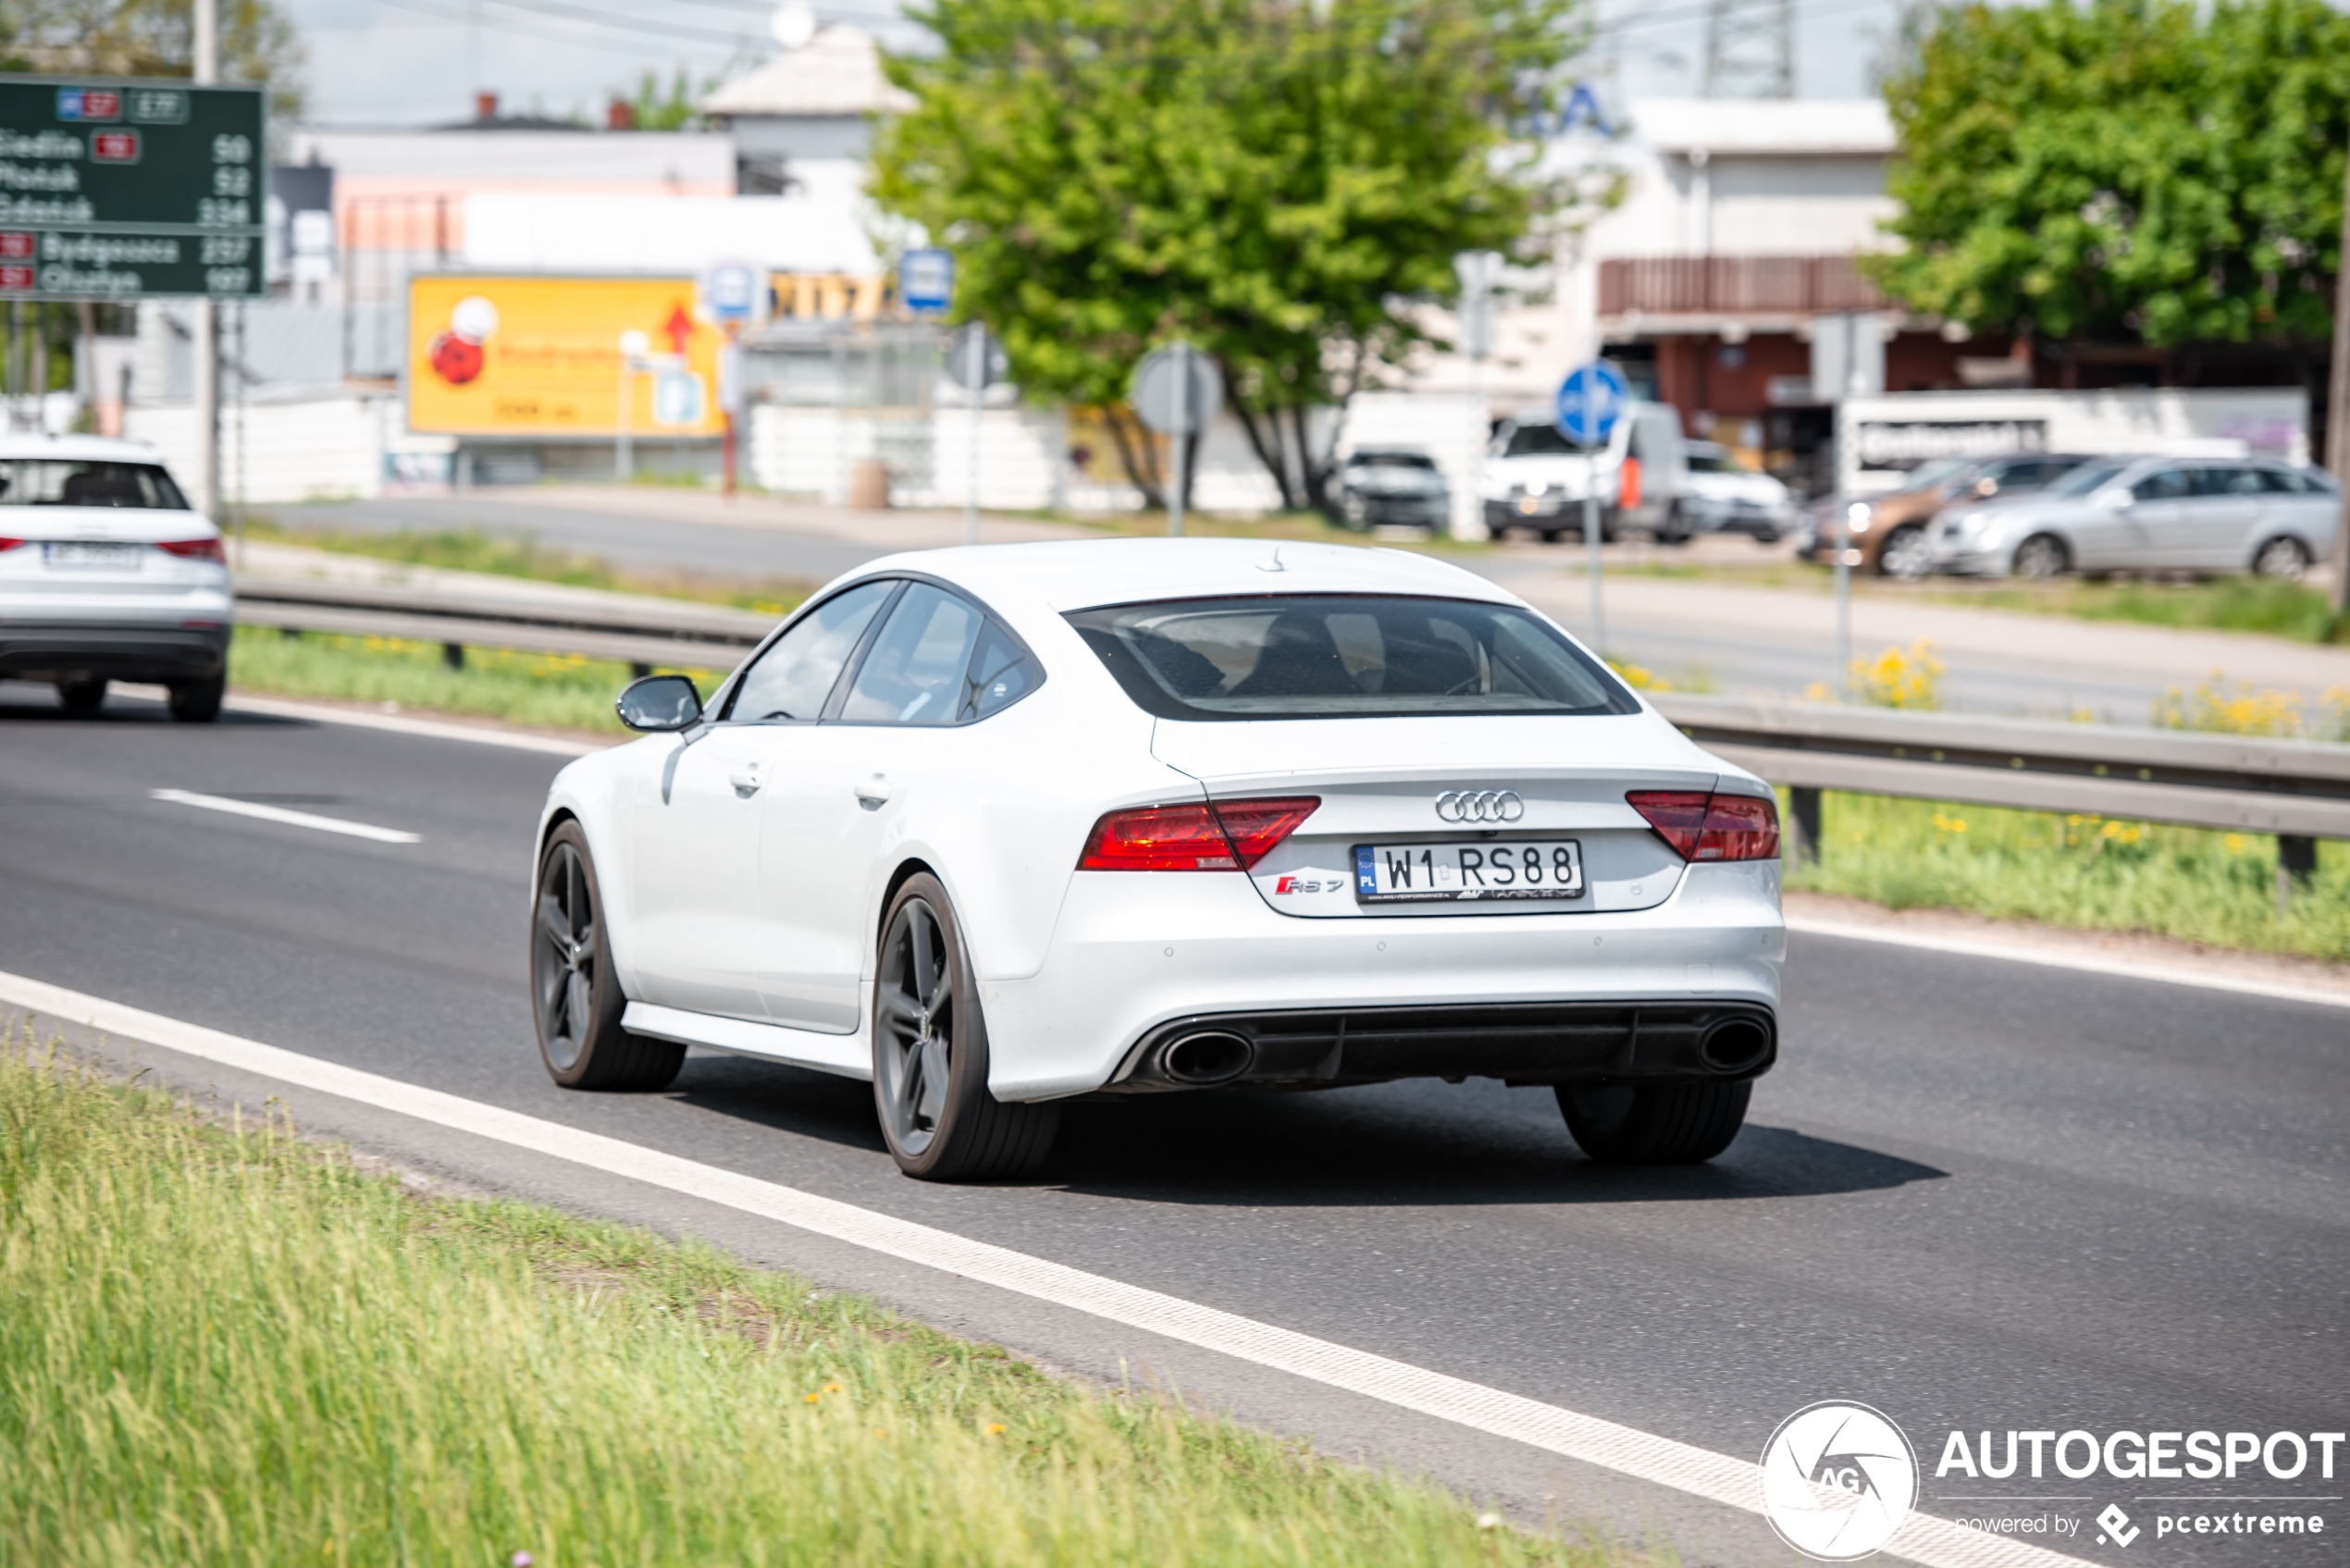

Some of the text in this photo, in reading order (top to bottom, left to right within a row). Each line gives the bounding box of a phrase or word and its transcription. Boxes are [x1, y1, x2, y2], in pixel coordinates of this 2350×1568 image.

[43, 232, 179, 268] Bydgoszcz
[1360, 875, 1376, 888] PL
[1386, 846, 1573, 888] W1 RS88
